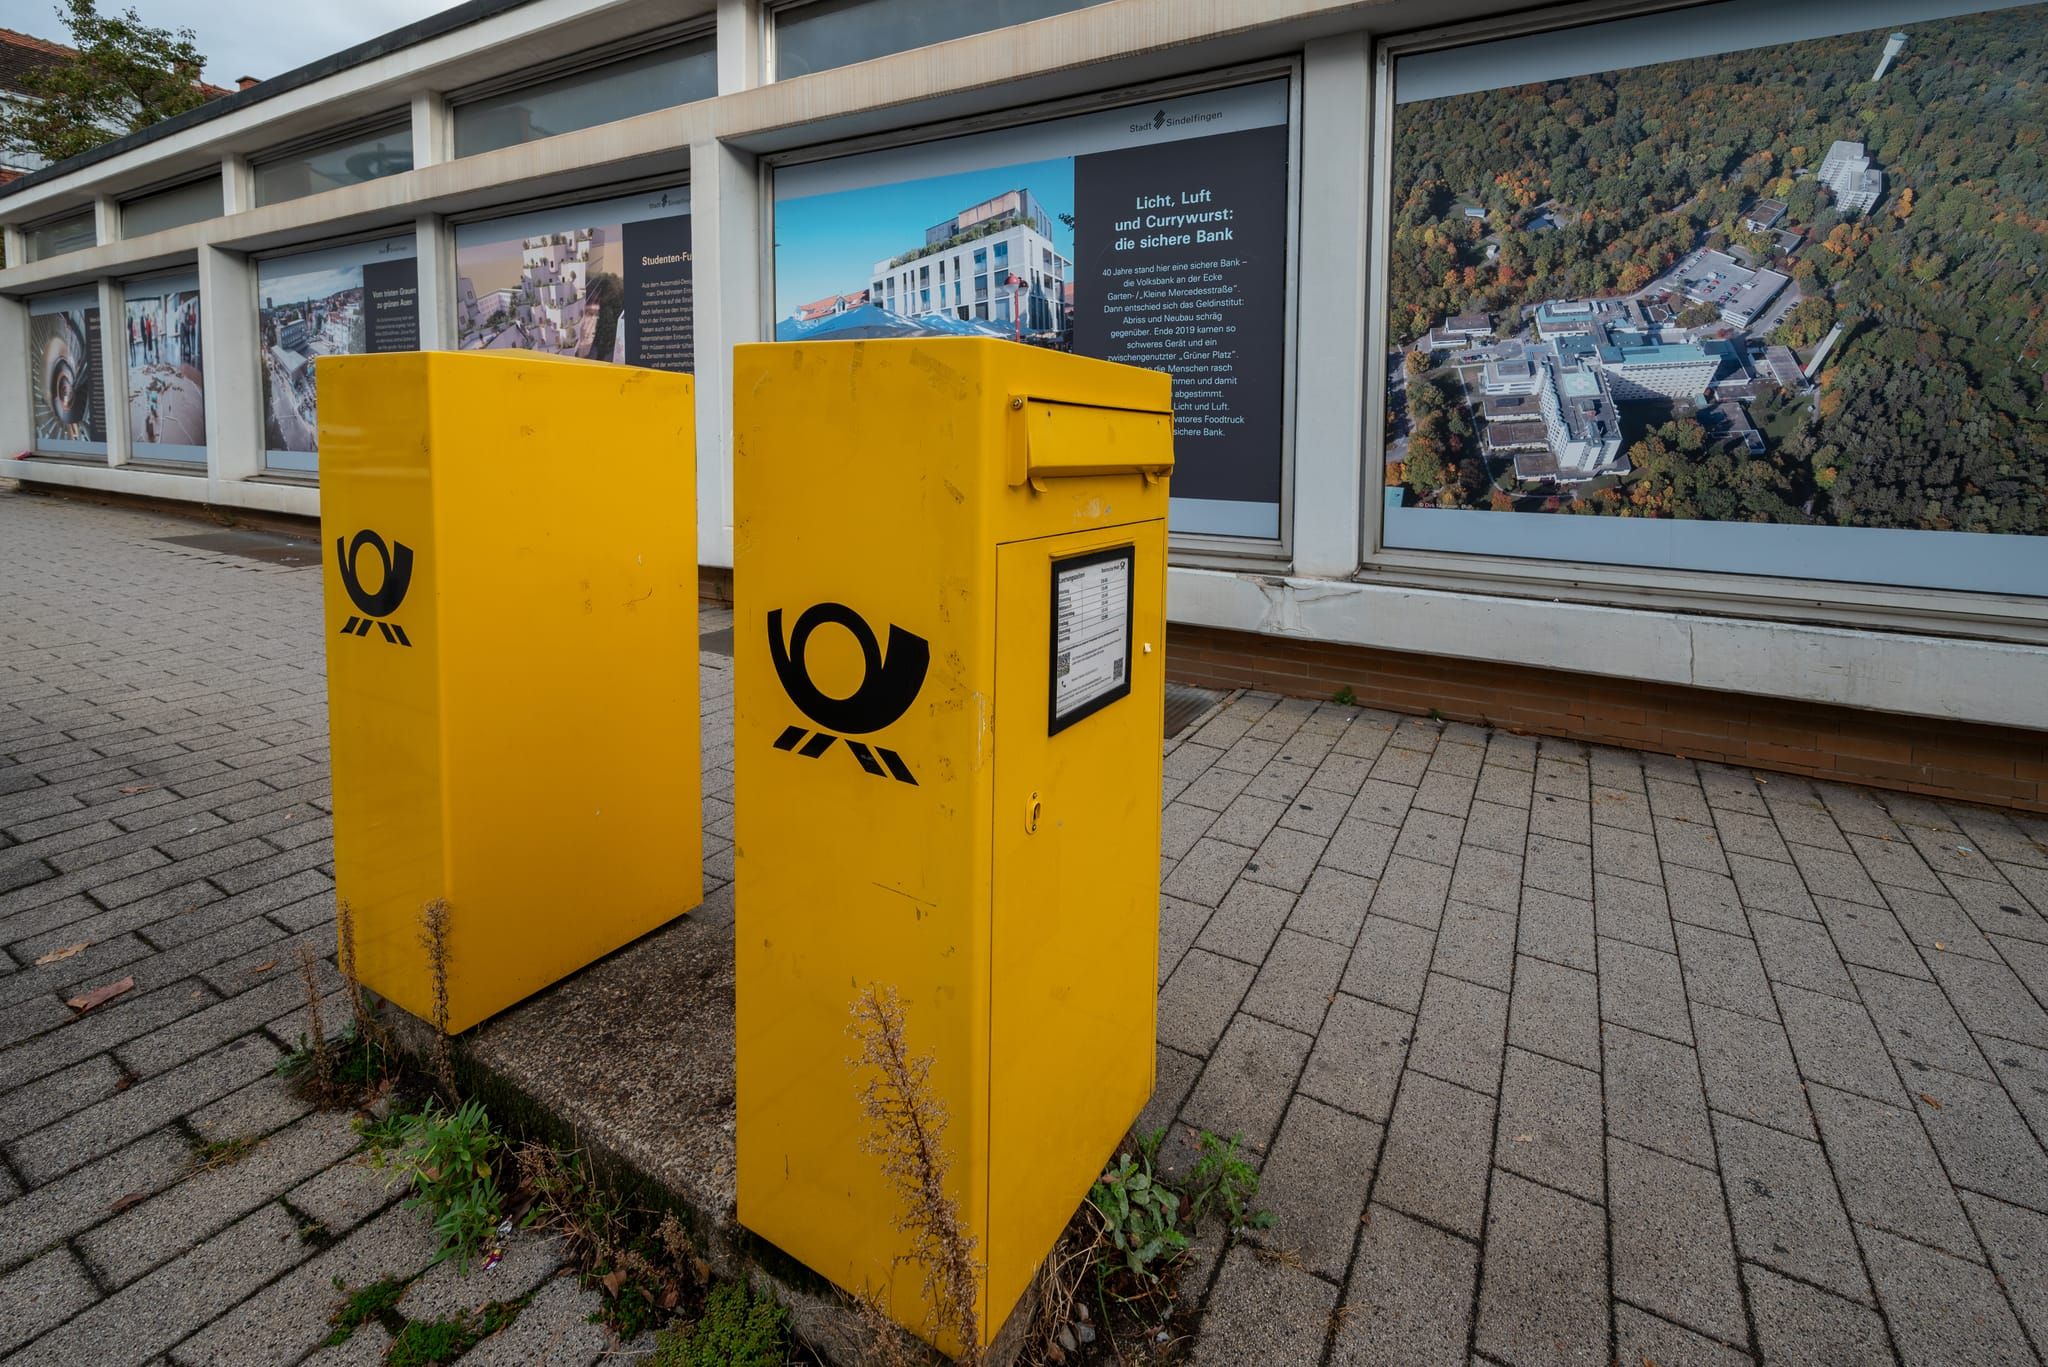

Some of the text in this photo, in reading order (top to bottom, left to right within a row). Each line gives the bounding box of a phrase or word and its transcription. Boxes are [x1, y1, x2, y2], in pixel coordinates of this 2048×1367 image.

[1130, 112, 1222, 133] Stadt Sindelfingen
[1136, 189, 1212, 210] Licht, Luft
[1115, 208, 1233, 232] und Currywurst:
[1115, 228, 1233, 250] die sichere Bank
[642, 252, 692, 266] Studenten-Fu
[1112, 267, 1132, 276] Jahre
[1134, 265, 1154, 274] stand
[1156, 263, 1170, 272] hier
[1172, 263, 1188, 271] eine
[1190, 260, 1218, 270] sichere
[1220, 258, 1240, 268] Bank
[1124, 272, 1222, 288] die Volksbank an der Ecke
[1104, 298, 1244, 313] Dann entschied sich das Geldinstitut:
[1123, 312, 1222, 324] Abriss und Neubau schräg
[1111, 327, 1152, 338] gegenüber.
[1154, 327, 1173, 336] Ende
[1175, 326, 1195, 334] 2019
[1197, 325, 1224, 334] kamen
[1127, 338, 1218, 350] schweres Gerät und ein
[1108, 352, 1176, 363] zwischengenutzter
[1168, 364, 1208, 373] Menschen
[1211, 364, 1232, 372] rasch
[1198, 377, 1212, 385] und
[1214, 376, 1238, 385] damit
[1175, 390, 1224, 399] abgestimmt.
[1174, 402, 1230, 411] Licht und Luft.
[1204, 415, 1245, 424] Foodtruck
[1174, 427, 1226, 436] sichere Bank.
